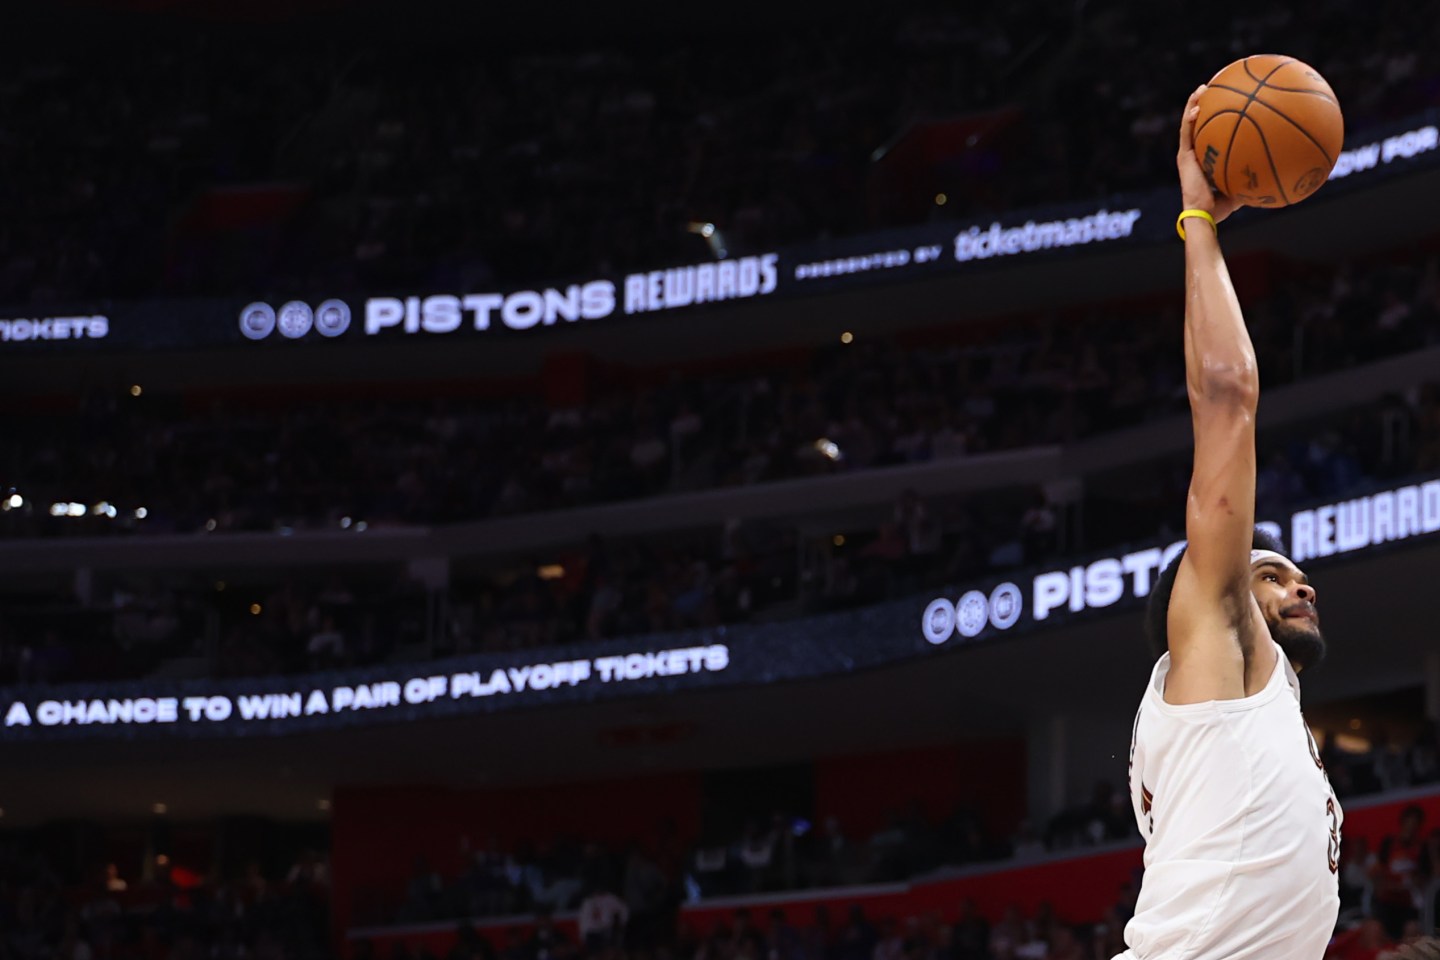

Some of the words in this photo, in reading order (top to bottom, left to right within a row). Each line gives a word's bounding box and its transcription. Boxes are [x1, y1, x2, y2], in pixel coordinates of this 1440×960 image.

[364, 279, 617, 335] PISTONS
[624, 252, 780, 314] REWARDS
[954, 209, 1142, 263] ticketmaster
[5, 701, 32, 726] A
[36, 698, 179, 726] CHANCE
[183, 695, 232, 722] TO
[238, 692, 303, 720] WIN
[305, 690, 329, 716] A
[332, 681, 401, 712] PAIR
[404, 677, 447, 704] OF
[451, 660, 591, 699] PLAYOFF
[595, 644, 729, 683] TICKETS
